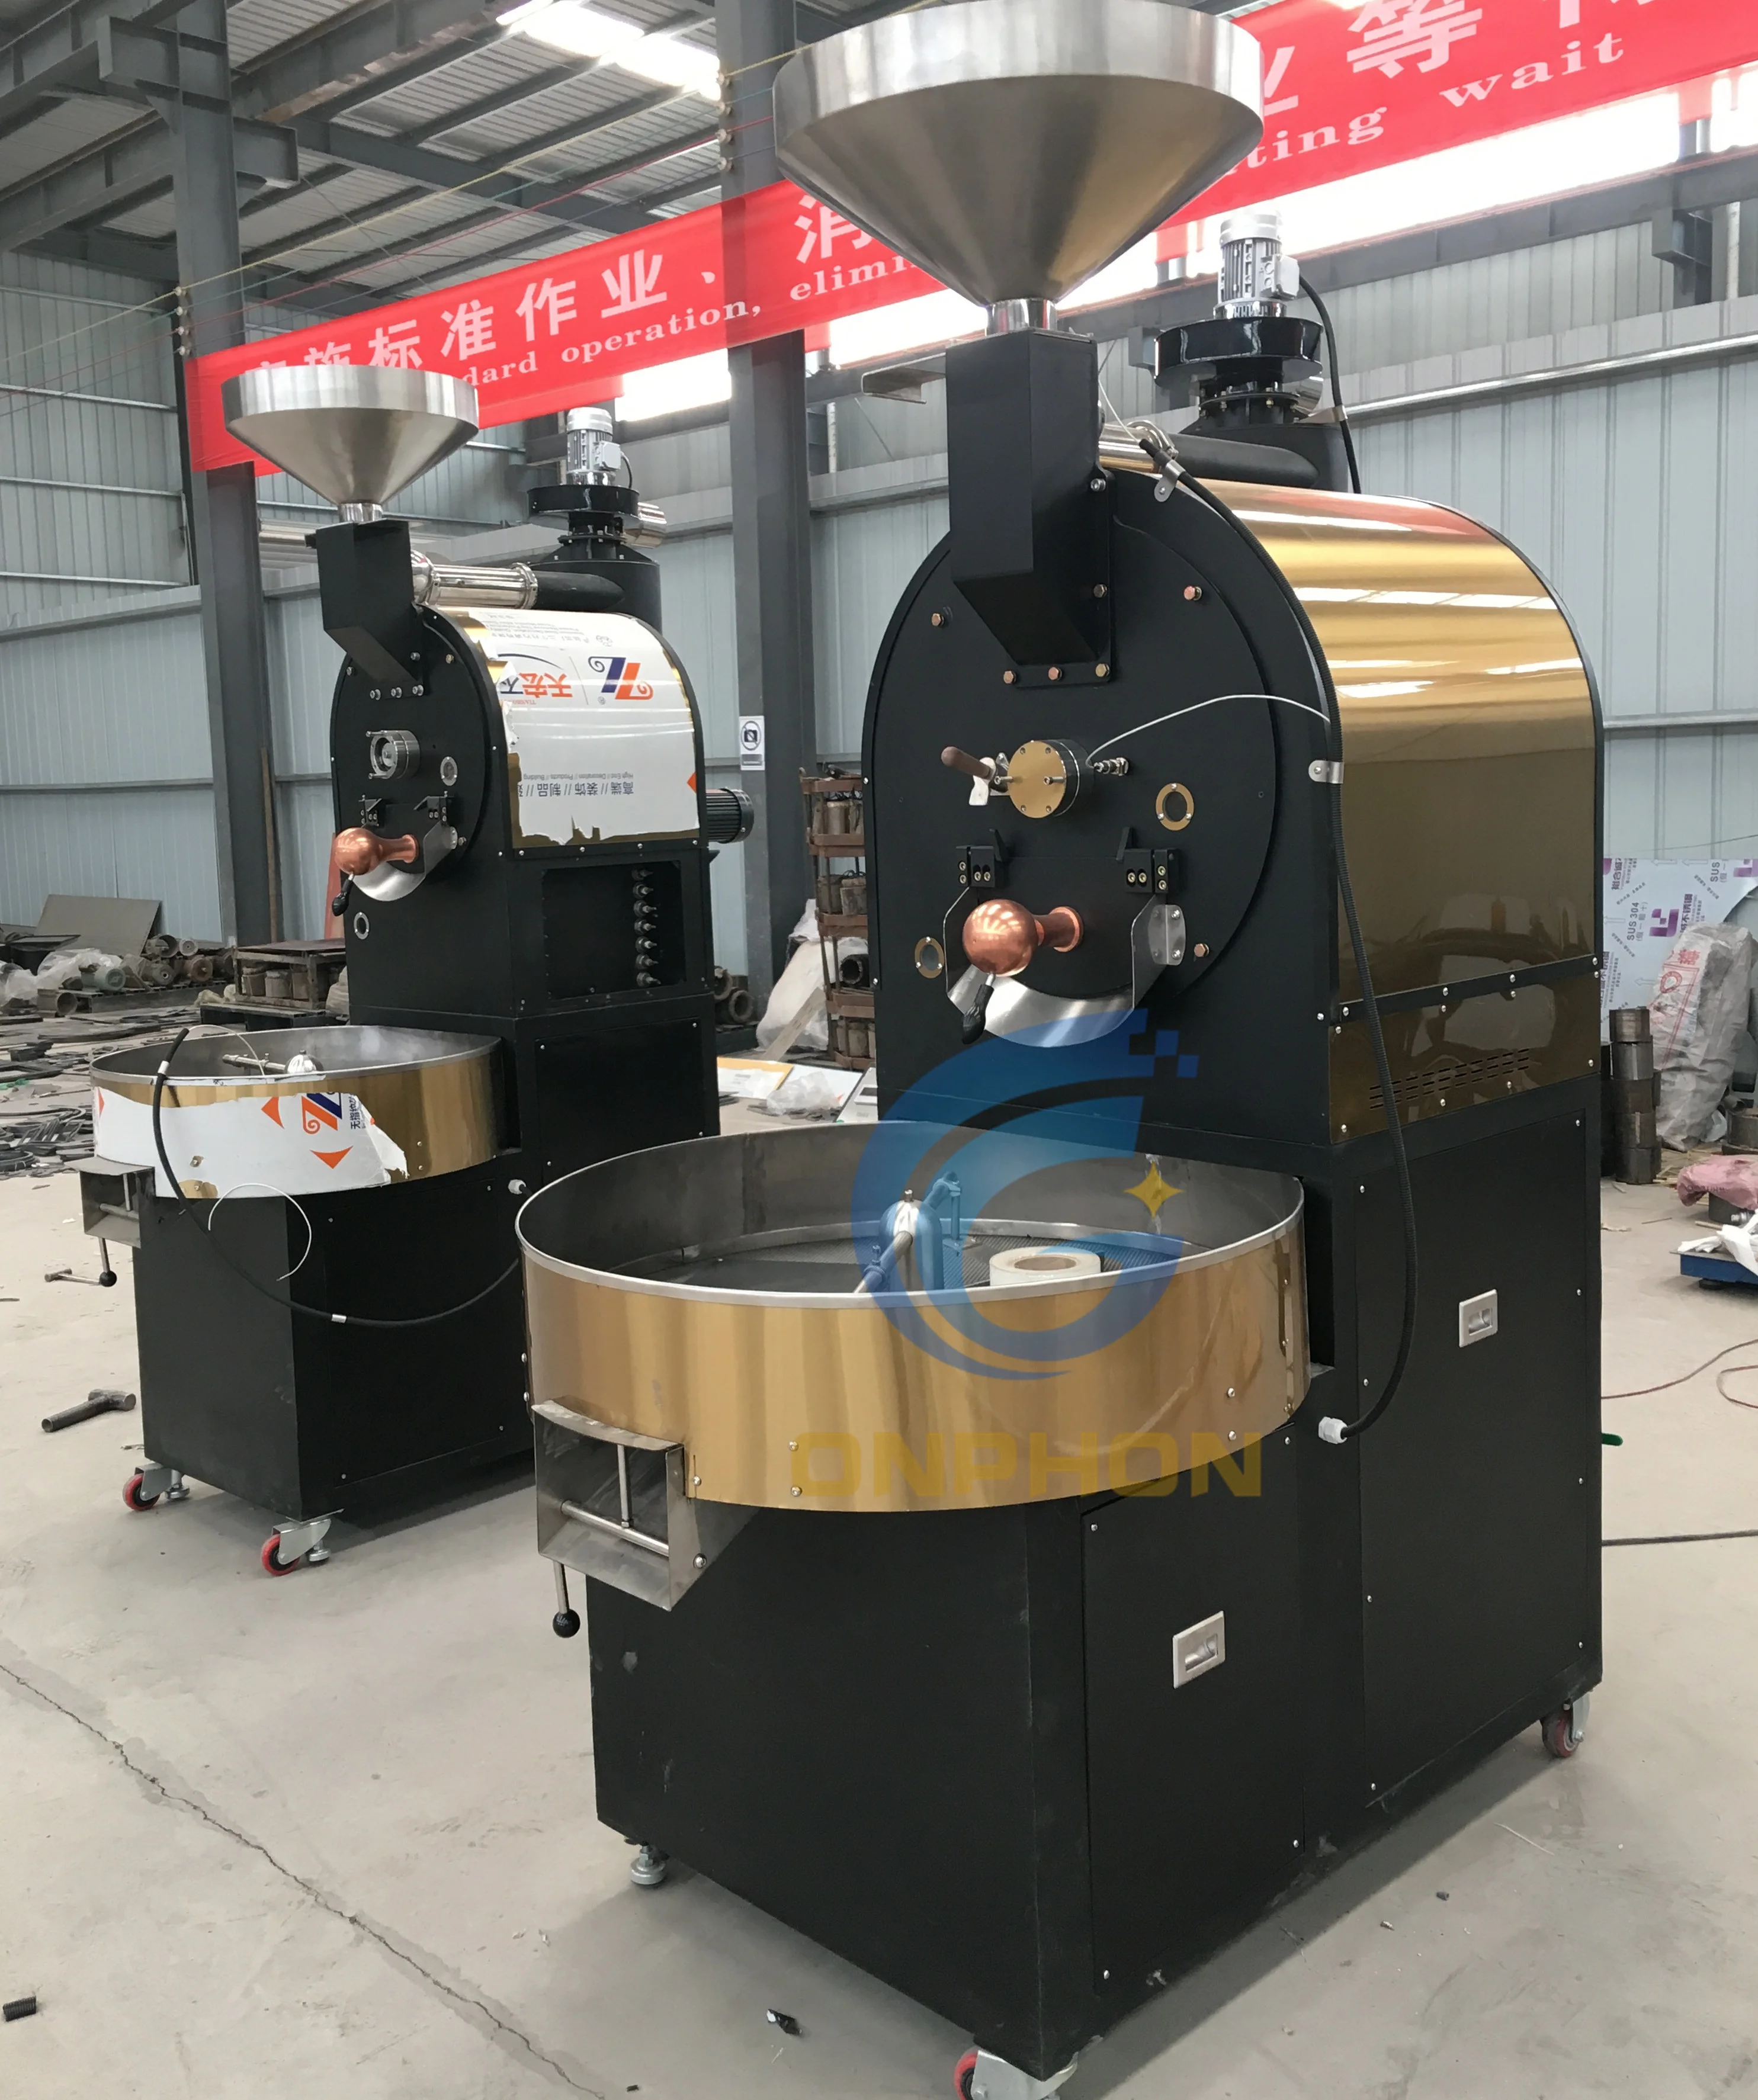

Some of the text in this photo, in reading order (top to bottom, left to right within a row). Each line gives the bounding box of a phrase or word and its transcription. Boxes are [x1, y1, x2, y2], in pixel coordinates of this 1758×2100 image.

[462, 351, 538, 386] dard
[561, 297, 761, 364] operation,
[1226, 106, 1388, 176] ting
[1439, 32, 1624, 108] wait
[1710, 862, 1721, 882] SUS
[1627, 902, 1640, 941] SUS 304
